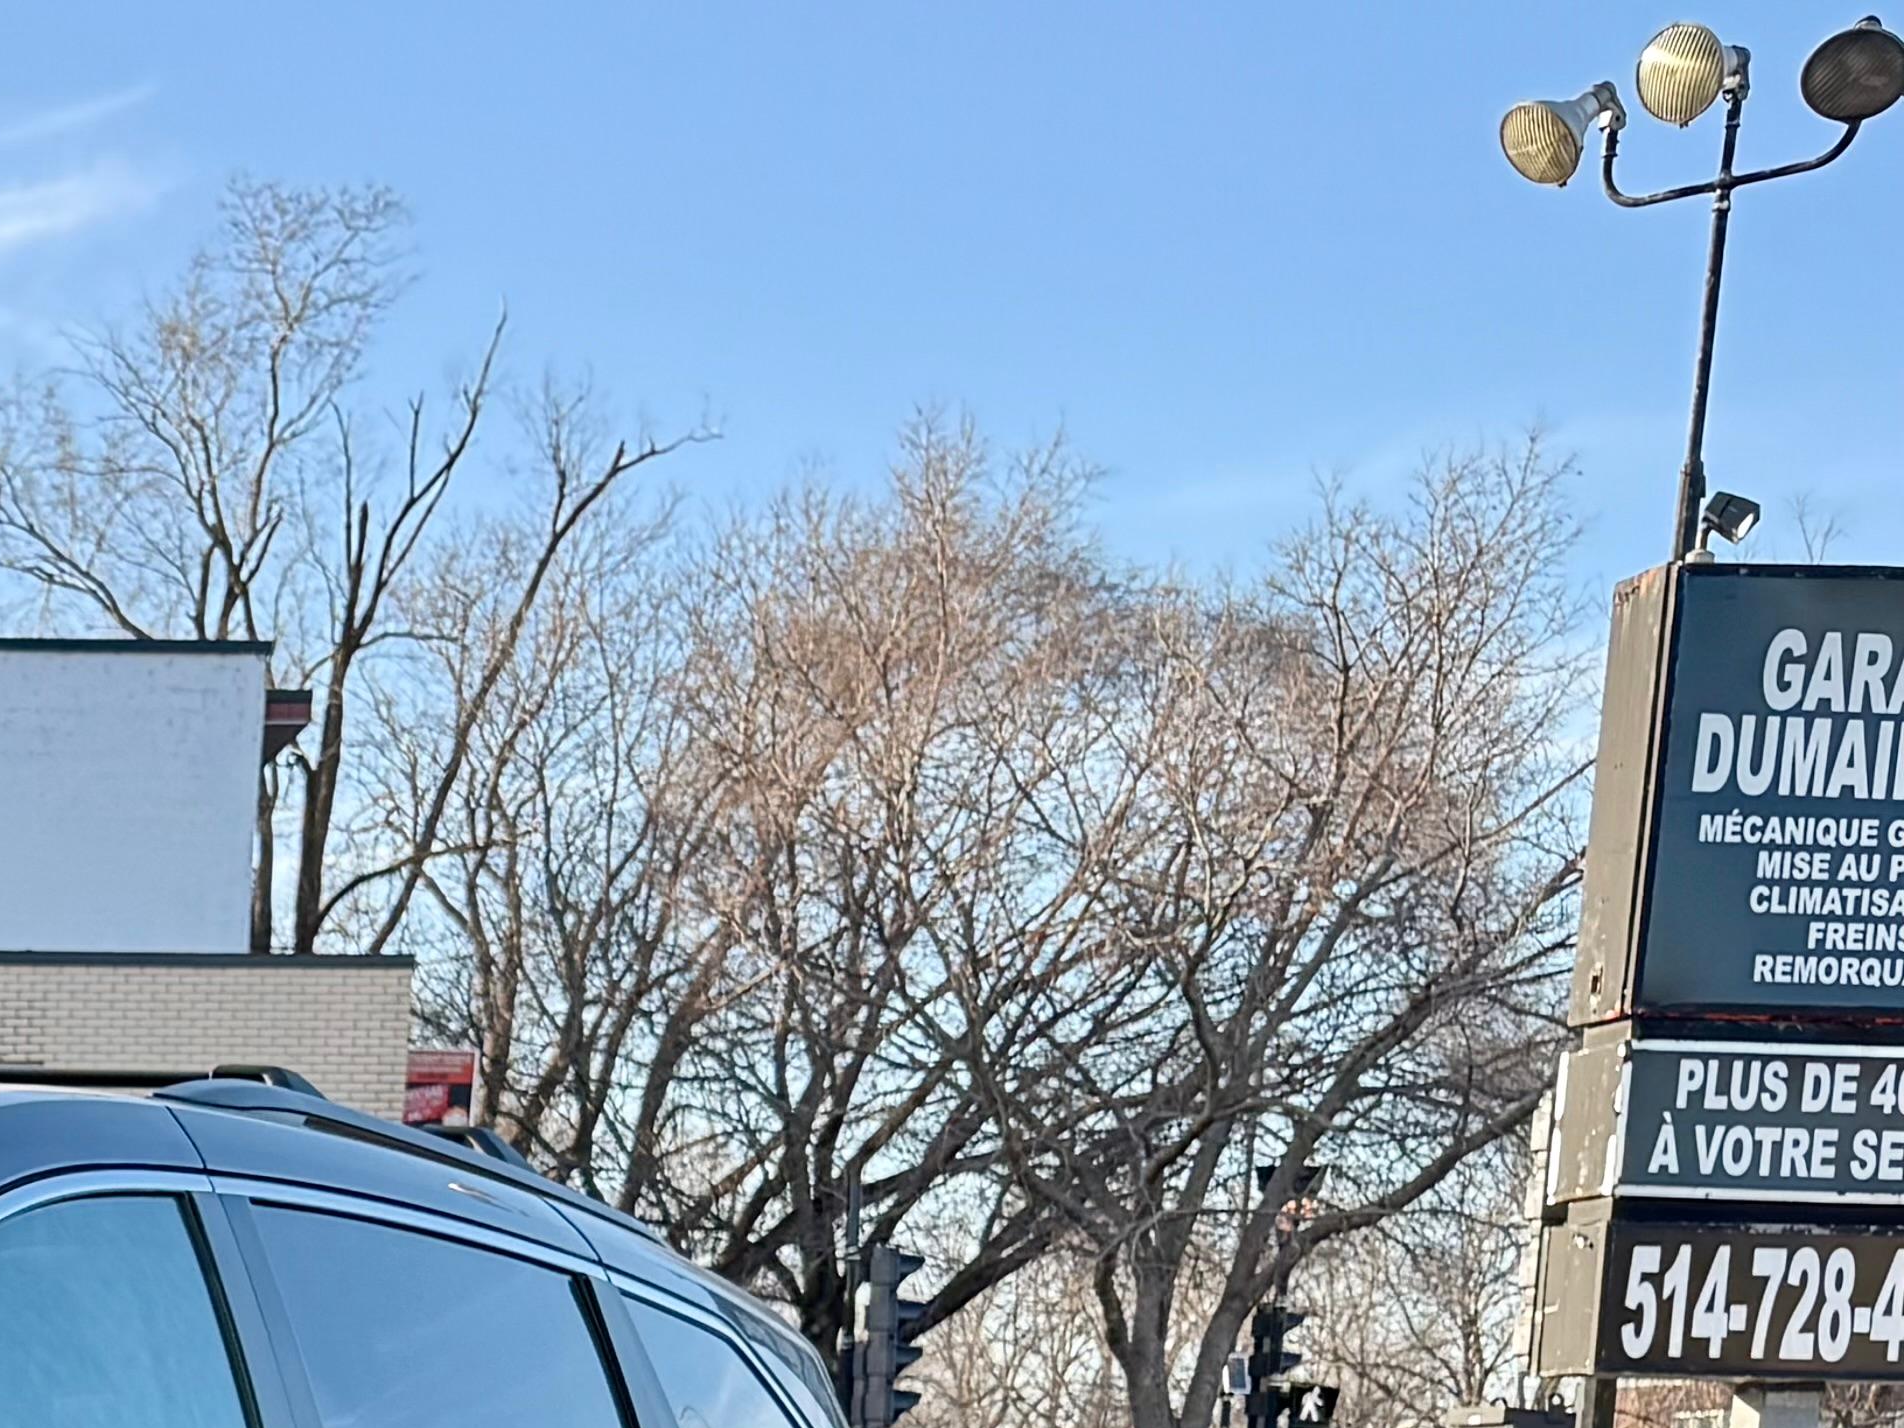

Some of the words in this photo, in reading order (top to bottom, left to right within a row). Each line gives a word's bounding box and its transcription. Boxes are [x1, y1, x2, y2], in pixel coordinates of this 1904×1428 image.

[1692, 713, 1904, 800] DUMAI
[1699, 809, 1880, 847] MÉCANIQUE
[1756, 851, 1831, 880] MISE
[1837, 853, 1881, 882] AU
[1808, 922, 1904, 952] FREIN
[1753, 955, 1904, 987] REMORQU
[1676, 1058, 1788, 1112] PLUS
[1801, 1062, 1860, 1114] DE
[1870, 1064, 1904, 1115] 4
[1647, 1111, 1679, 1174] À
[1695, 1125, 1838, 1178] VOTRE
[1850, 1129, 1904, 1180] SE
[1621, 1244, 1904, 1362] 514-728-4
